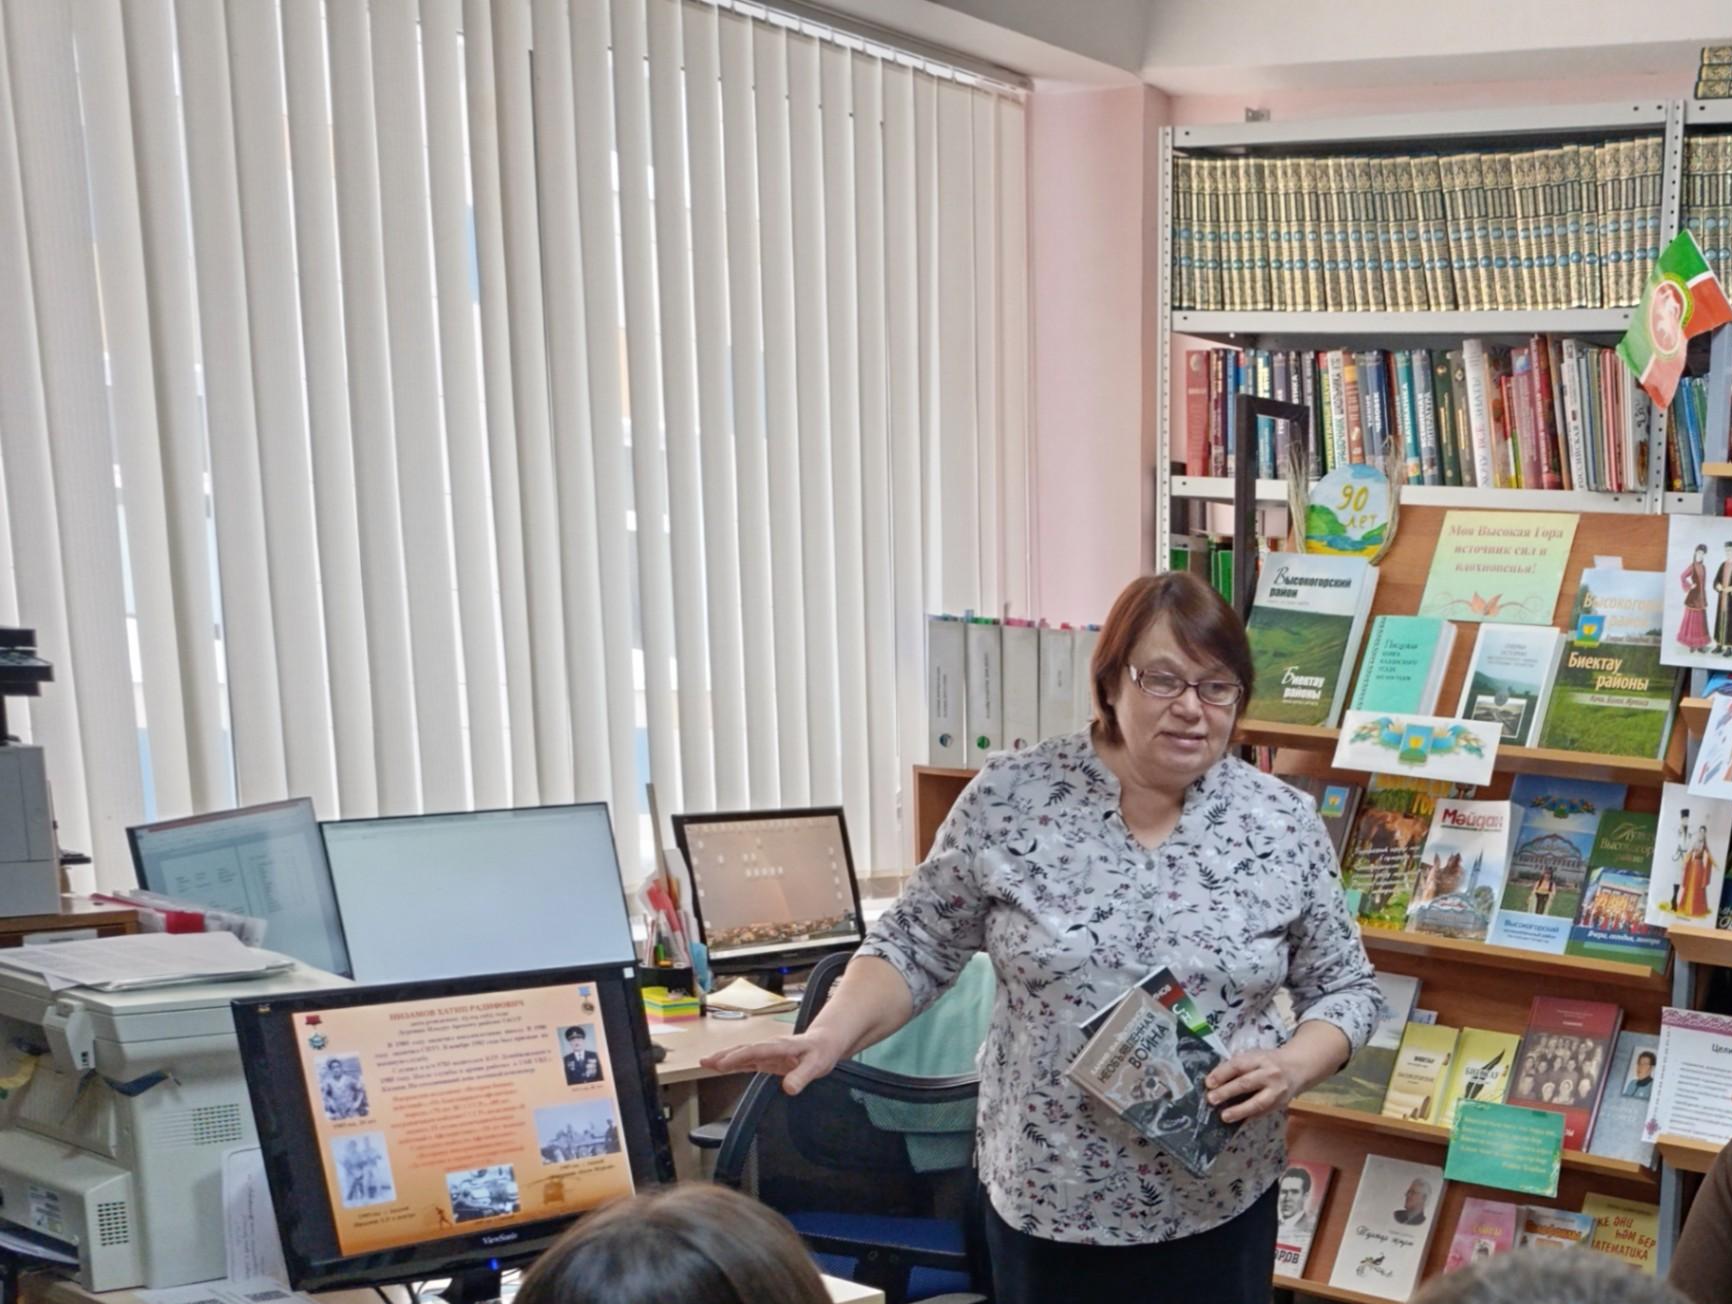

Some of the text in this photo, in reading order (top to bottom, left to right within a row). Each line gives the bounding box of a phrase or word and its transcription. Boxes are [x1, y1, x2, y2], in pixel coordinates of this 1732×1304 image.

[1336, 484, 1369, 512] 90
[1477, 526, 1531, 539] Высокая
[1273, 566, 1352, 589] Высокогорский
[1269, 587, 1299, 599] район
[1568, 652, 1623, 672] Биектау
[1281, 665, 1326, 688] Биектау
[1596, 674, 1649, 692] районы
[1440, 808, 1504, 828] Мәйдан
[1097, 1011, 1156, 1083] НЕОБЪЯВЛЕННАЯ
[1127, 1022, 1170, 1070] ВОЙНА
[482, 1232, 518, 1246] ViewSonic
[1637, 1234, 1657, 1249] БЕР
[1592, 1239, 1649, 1261] АТЕМАТИКА
